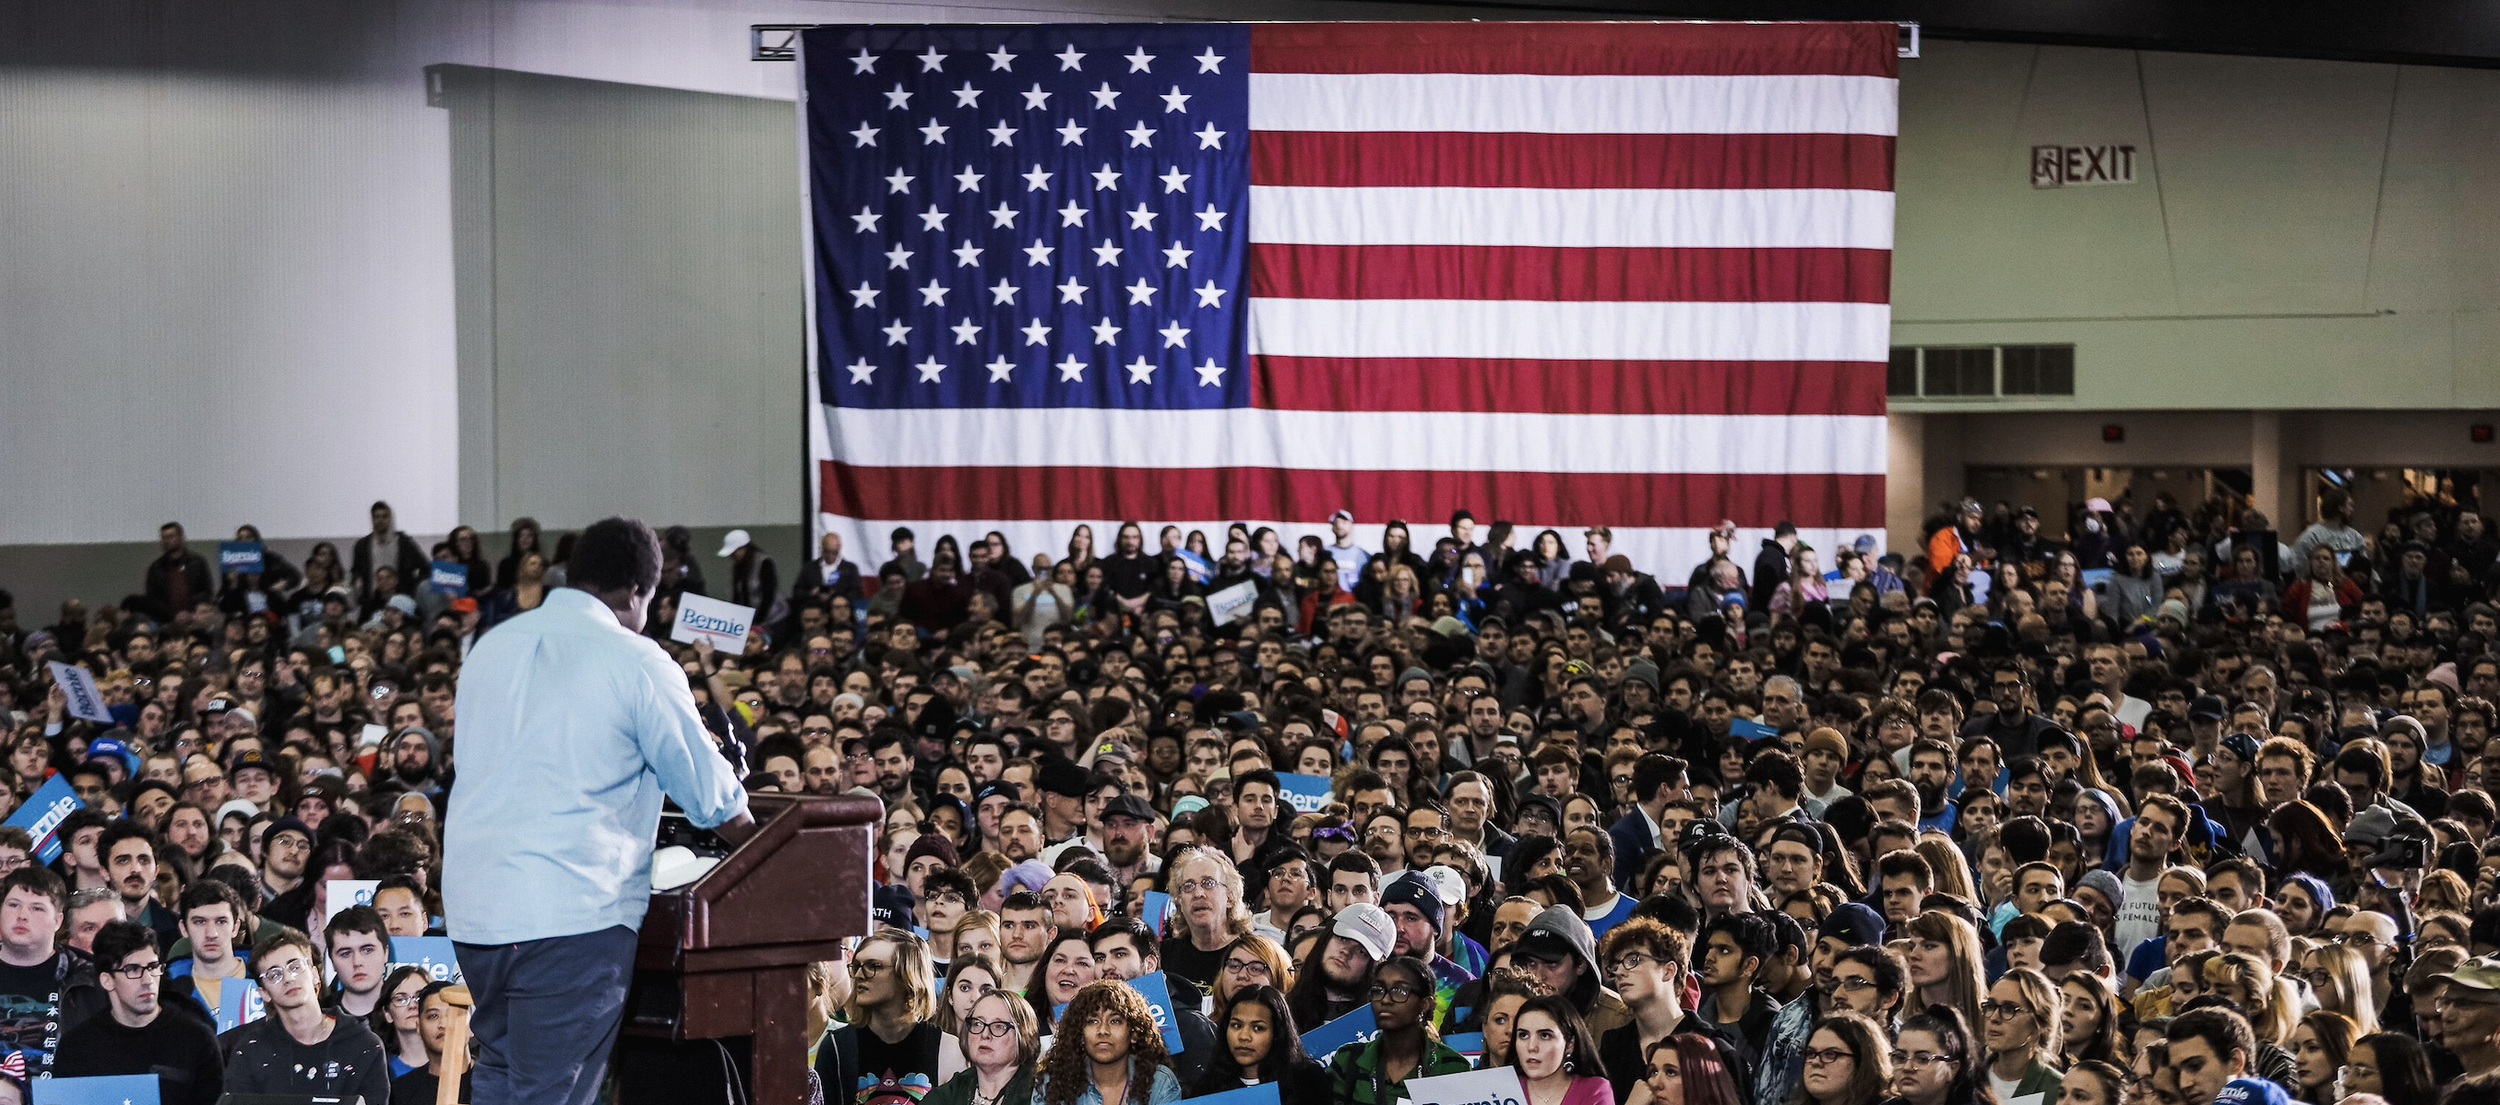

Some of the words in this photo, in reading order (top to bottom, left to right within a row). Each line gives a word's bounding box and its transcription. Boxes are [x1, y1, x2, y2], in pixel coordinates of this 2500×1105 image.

[2066, 145, 2137, 182] EXIT
[682, 607, 745, 637] Bernie
[26, 795, 77, 853] ernie
[872, 907, 892, 919] ATH
[2122, 913, 2160, 924] FEMALE
[2216, 1086, 2250, 1101] ernie
